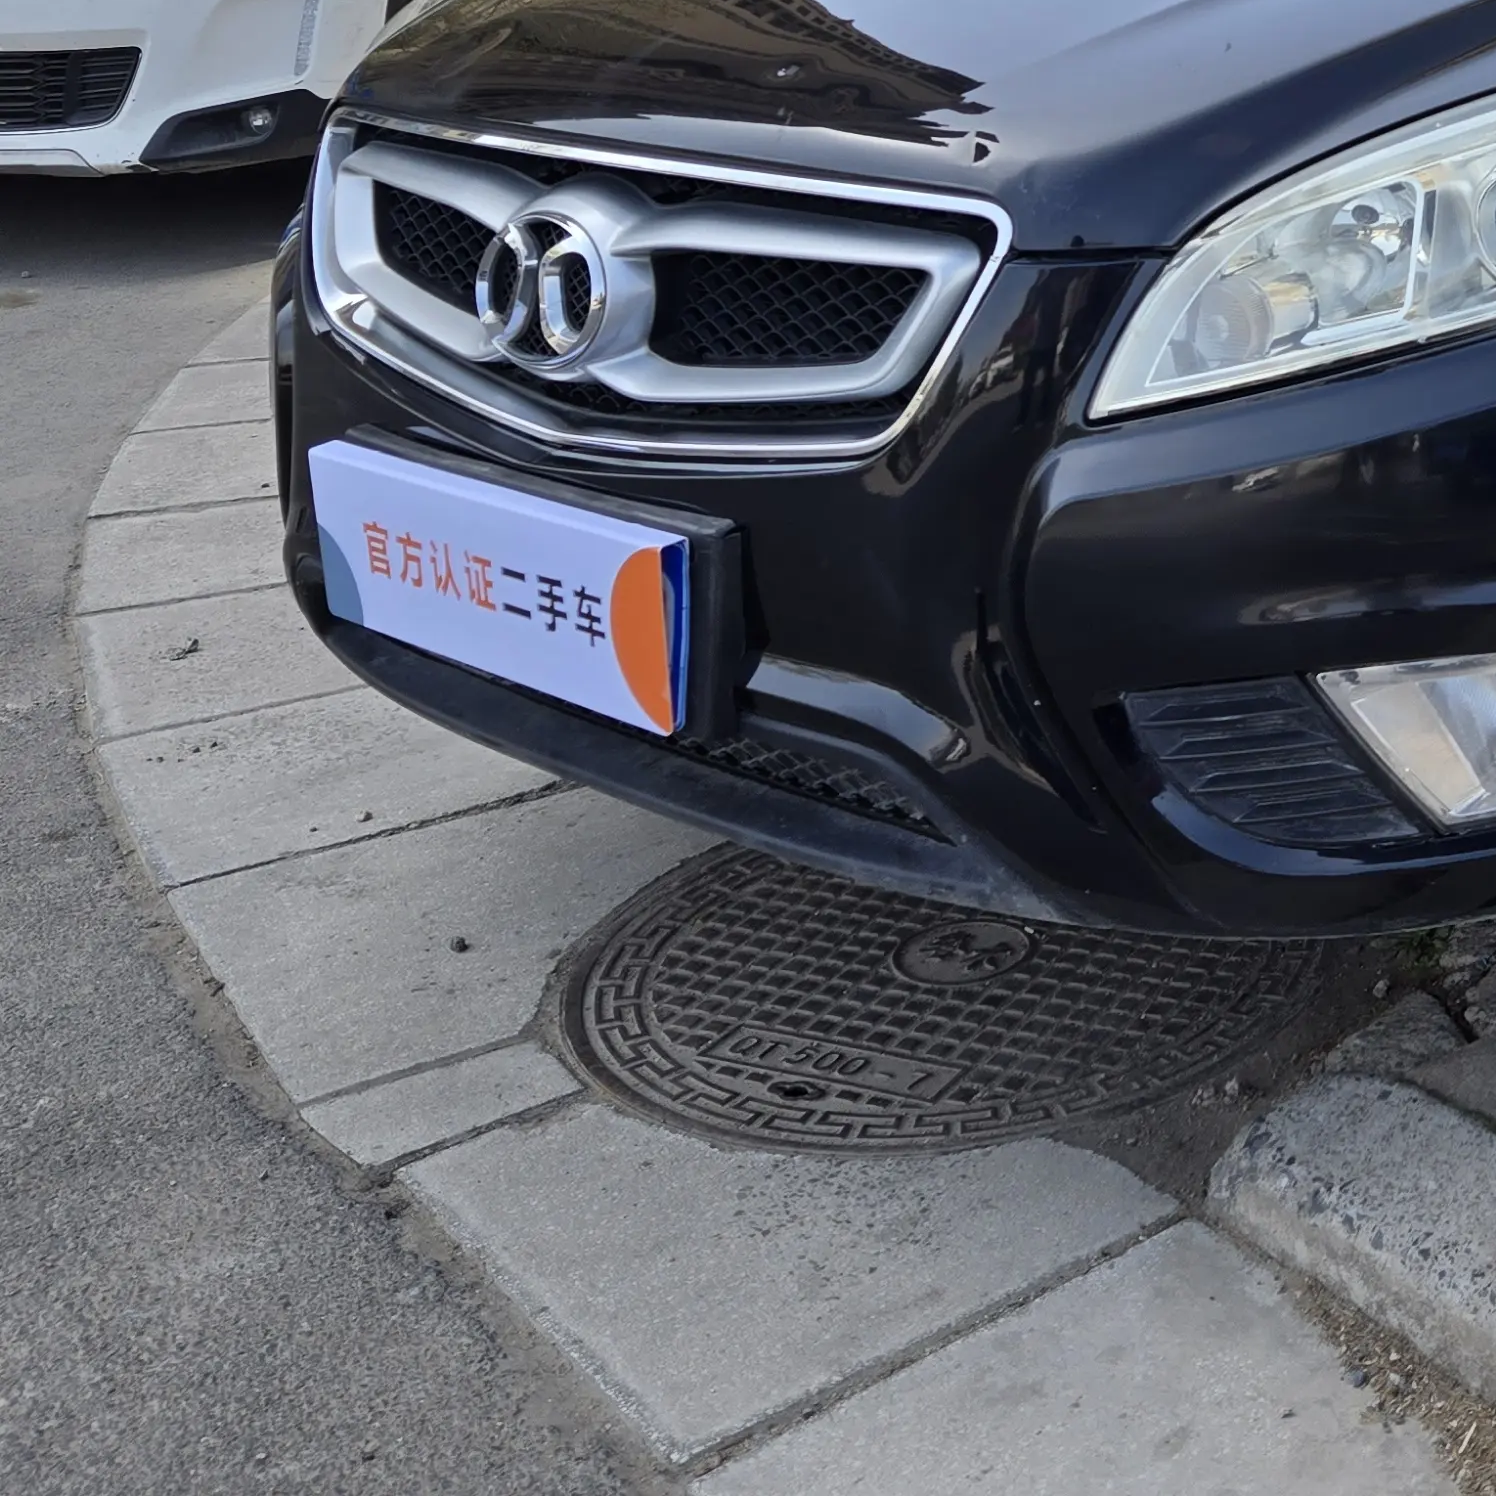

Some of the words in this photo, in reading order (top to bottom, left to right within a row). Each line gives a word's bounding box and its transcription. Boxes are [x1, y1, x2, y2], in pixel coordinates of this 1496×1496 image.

[362, 521, 607, 648] 官方认证二手车
